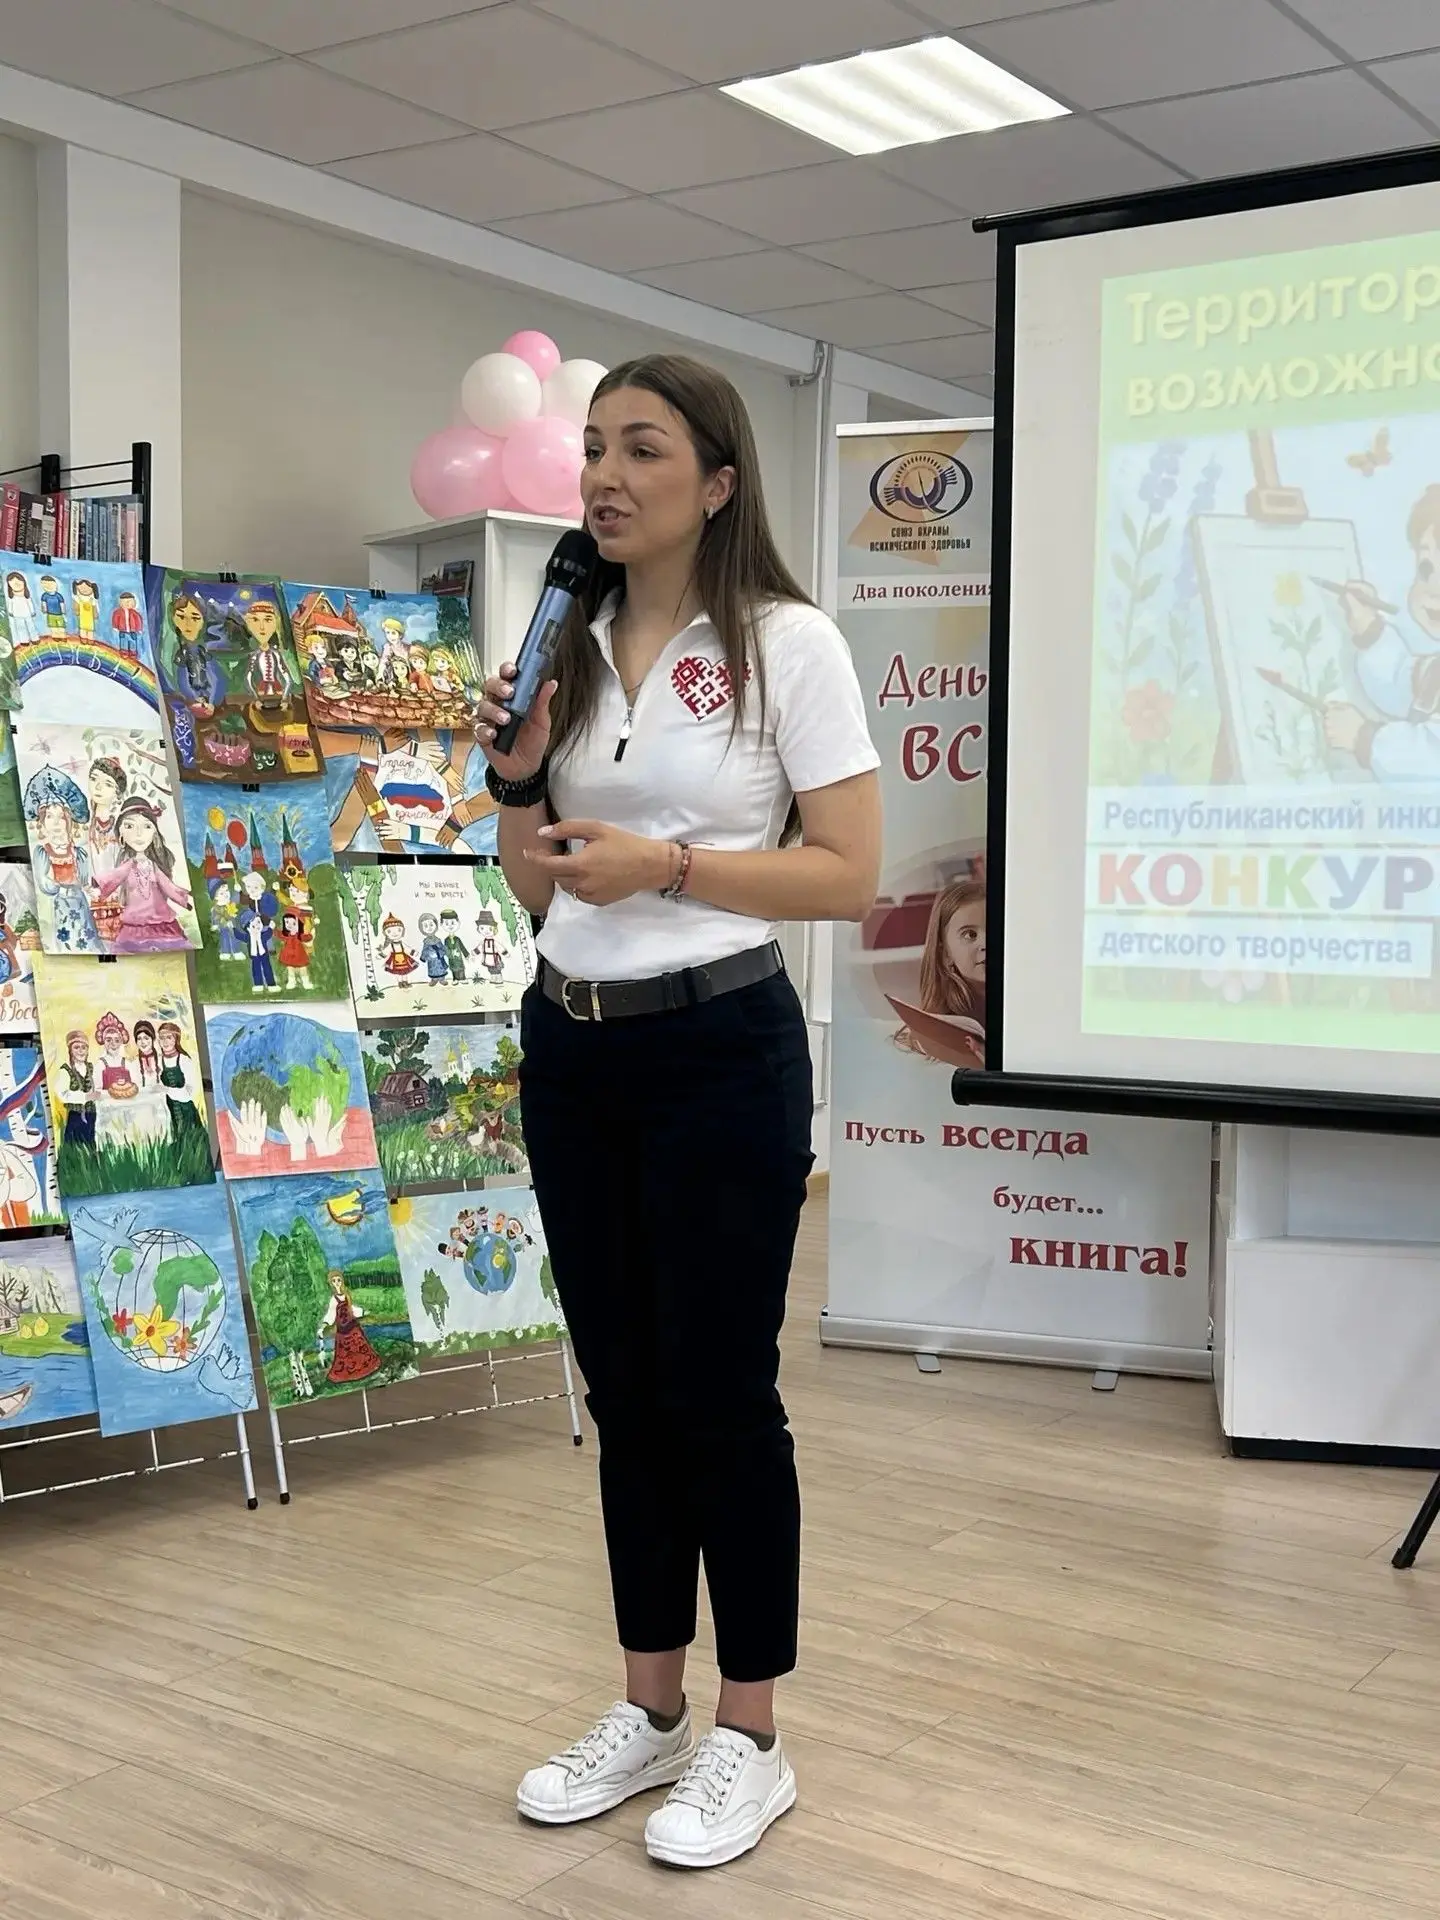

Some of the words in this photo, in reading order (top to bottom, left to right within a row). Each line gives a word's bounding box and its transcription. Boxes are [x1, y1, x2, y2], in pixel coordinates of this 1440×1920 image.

[1126, 264, 1440, 348] Территор
[870, 541, 926, 552] ПСИХИЧЕСКОГО
[931, 539, 970, 551] ЗДОРОВЬЯ
[891, 527, 912, 538] СОЮЗ
[918, 526, 949, 537] ОХРАНЫ
[853, 584, 887, 602] Два
[879, 654, 987, 708] День
[1104, 800, 1363, 836] Республиканский
[1378, 805, 1440, 830] инк
[1098, 853, 1434, 911] КОНКУР
[1100, 931, 1226, 957] детского
[1236, 936, 1412, 965] творчества
[845, 1121, 925, 1147] Пусть
[941, 1123, 1089, 1162] всегда
[993, 1185, 1104, 1215] будет...
[1009, 1237, 1189, 1278] книга!
